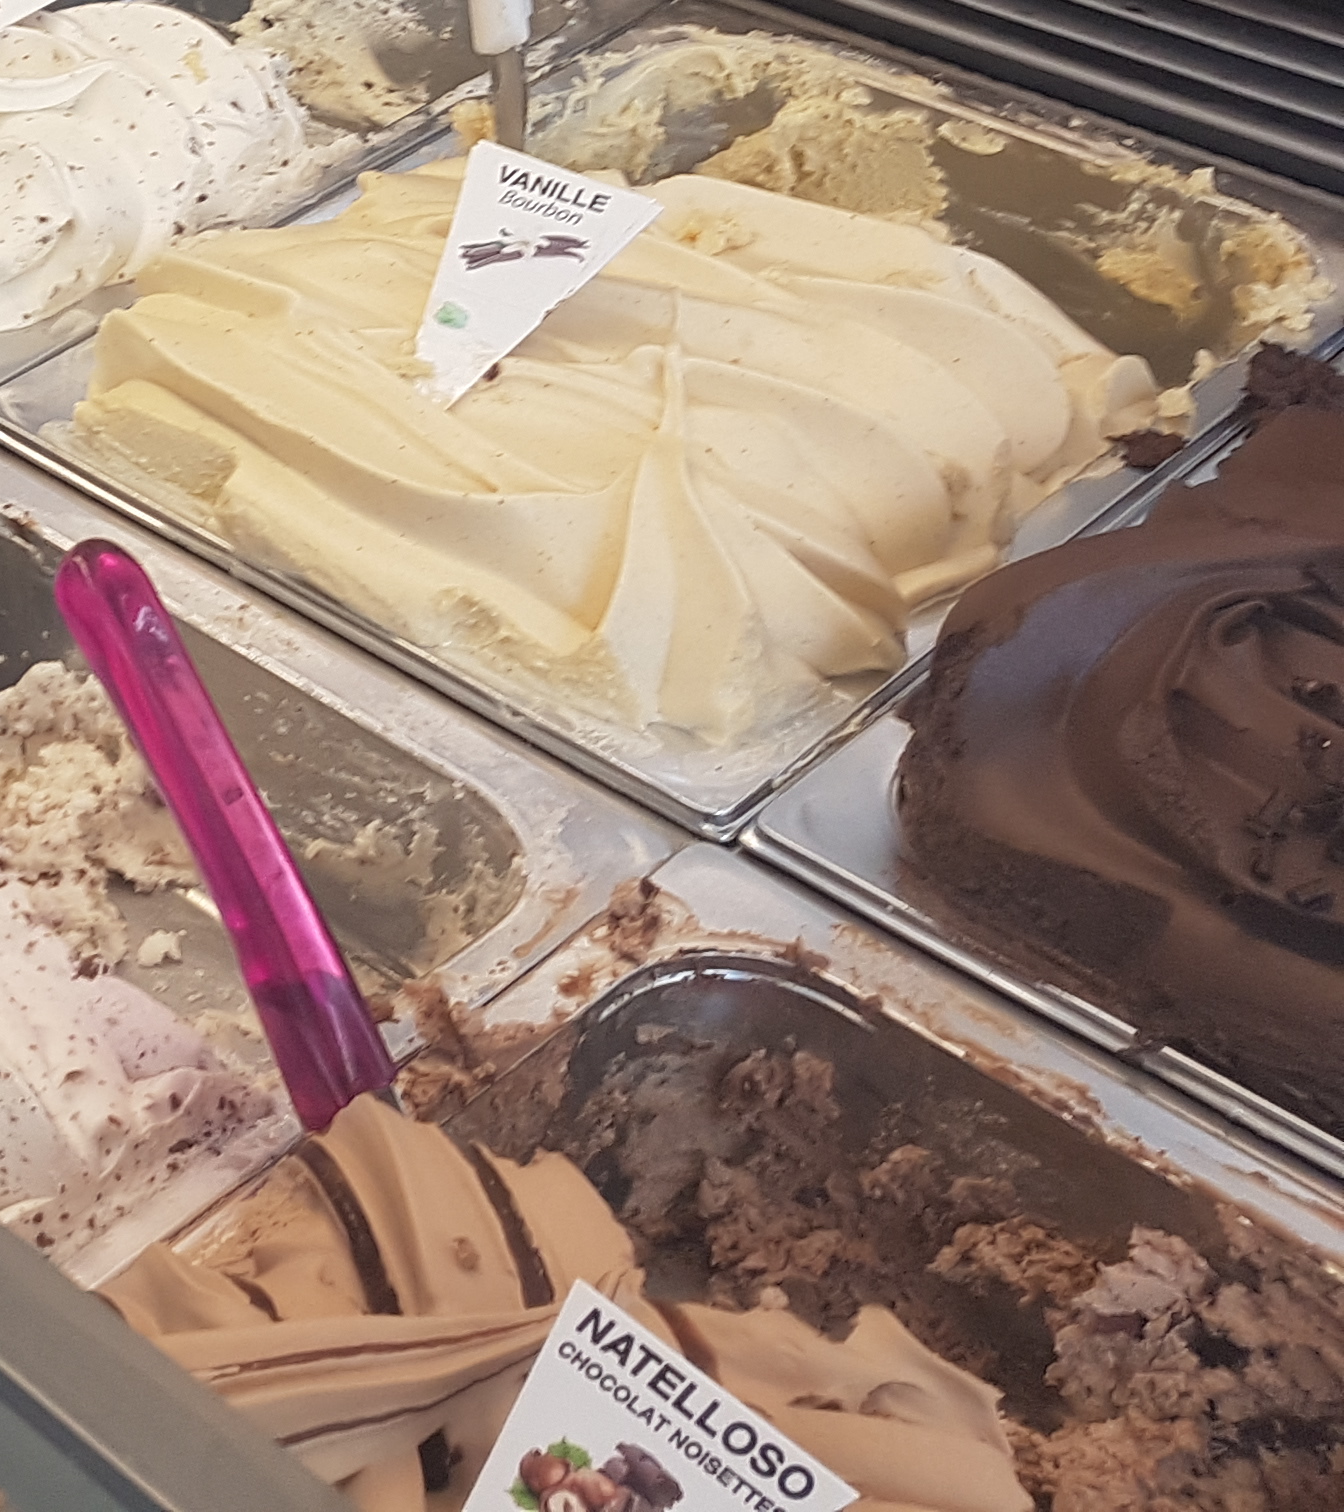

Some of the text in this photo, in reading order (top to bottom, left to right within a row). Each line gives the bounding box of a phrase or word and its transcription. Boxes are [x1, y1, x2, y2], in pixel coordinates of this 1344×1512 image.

[498, 189, 584, 226] Bourbon
[499, 164, 612, 214] VANILLE
[557, 1341, 786, 1512] CHOCOLAT NOISETTE
[574, 1306, 816, 1501] NATELLOSO
